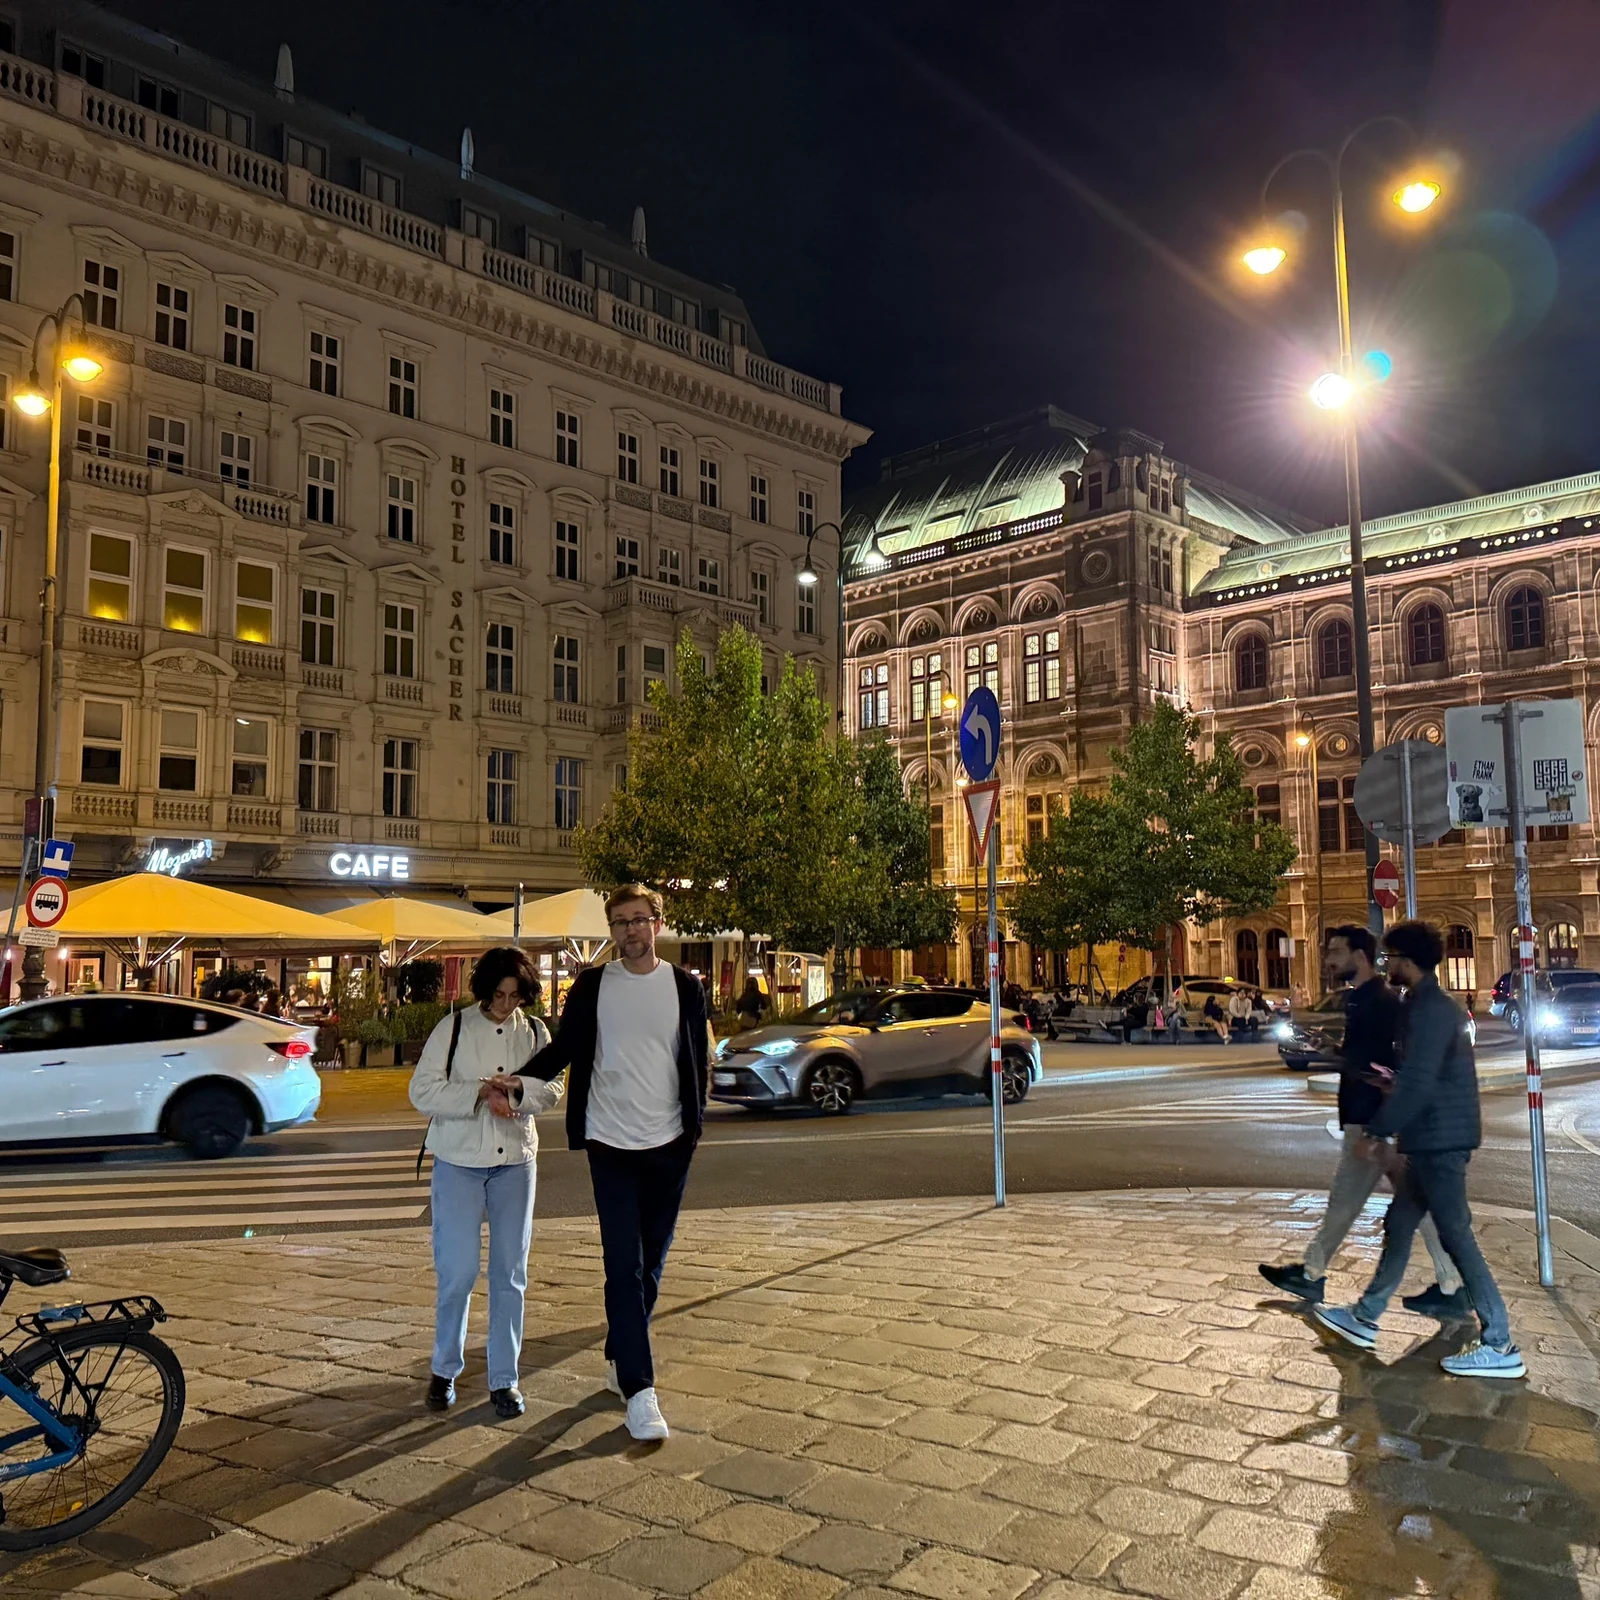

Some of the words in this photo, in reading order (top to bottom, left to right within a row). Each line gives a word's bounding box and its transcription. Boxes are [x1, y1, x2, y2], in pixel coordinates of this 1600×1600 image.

[451, 455, 466, 564] HOTEL
[448, 591, 464, 722] SACHER
[146, 841, 205, 877] Mozart
[330, 853, 409, 879] CAFE
